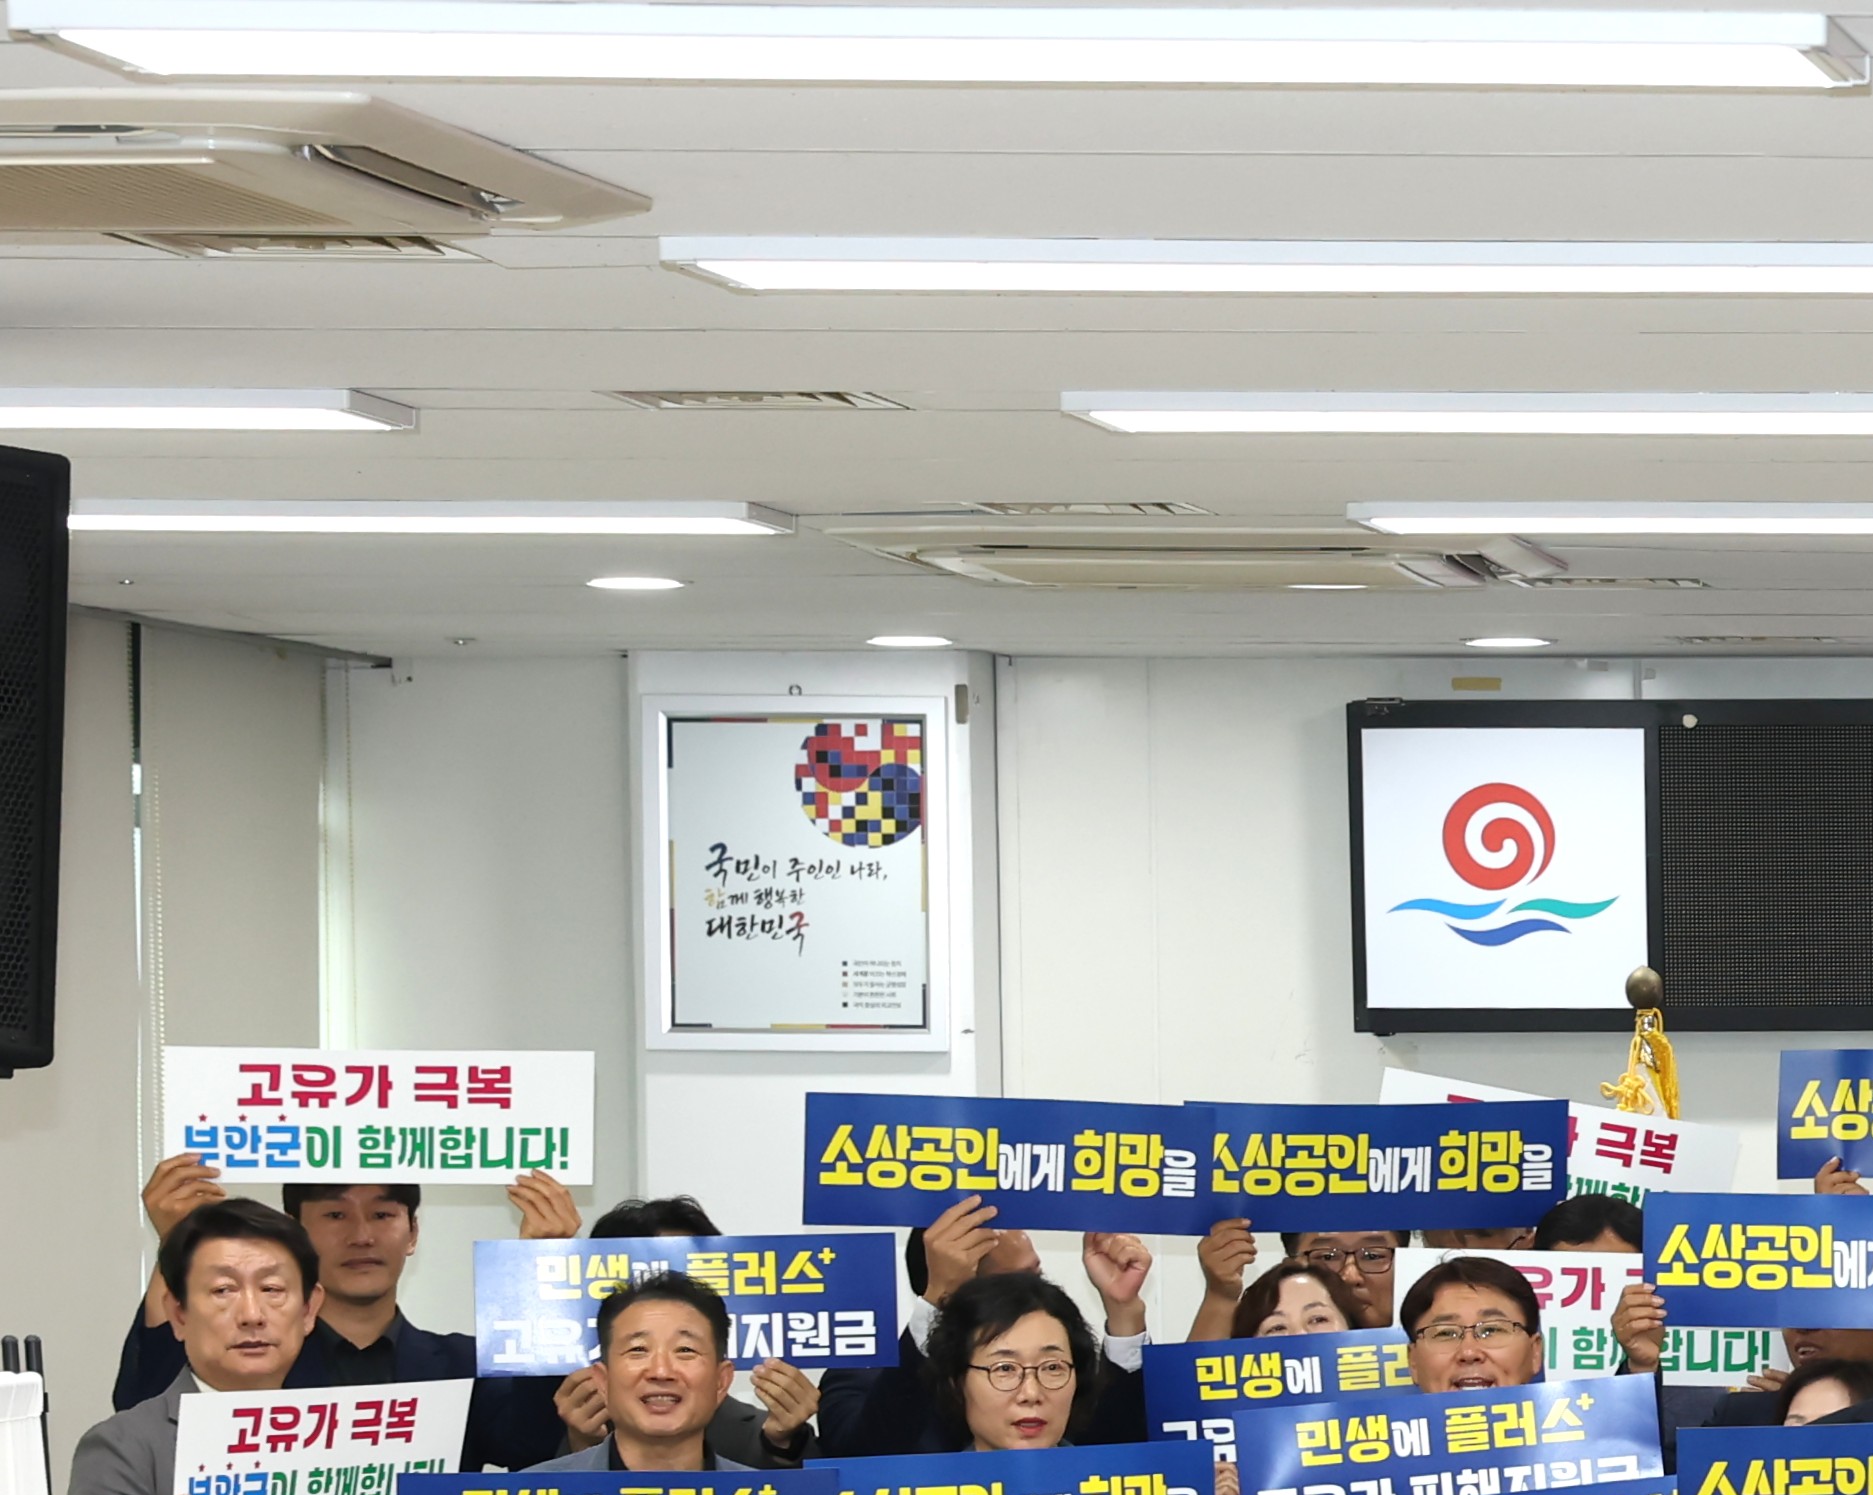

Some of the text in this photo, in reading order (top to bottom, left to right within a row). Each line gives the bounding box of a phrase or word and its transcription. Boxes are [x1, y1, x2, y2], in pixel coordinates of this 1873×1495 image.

[705, 842, 888, 887] 국민이 주인인 나라,
[704, 886, 805, 909] 함께 행복한
[705, 911, 810, 957] 대한민국
[239, 1064, 511, 1109] 고유가 극복
[184, 1126, 568, 1171] 부안군이 함께합니다!
[820, 1125, 1195, 1197] 소상공인에게 희망을
[1213, 1134, 1431, 1195] 소상공인에게
[1438, 1131, 1552, 1192] 희망을
[1596, 1123, 1678, 1173] 극복
[1196, 1353, 1322, 1400] 민생에
[228, 1398, 417, 1453] 고유가 극복
[1297, 1415, 1430, 1466] 민생에
